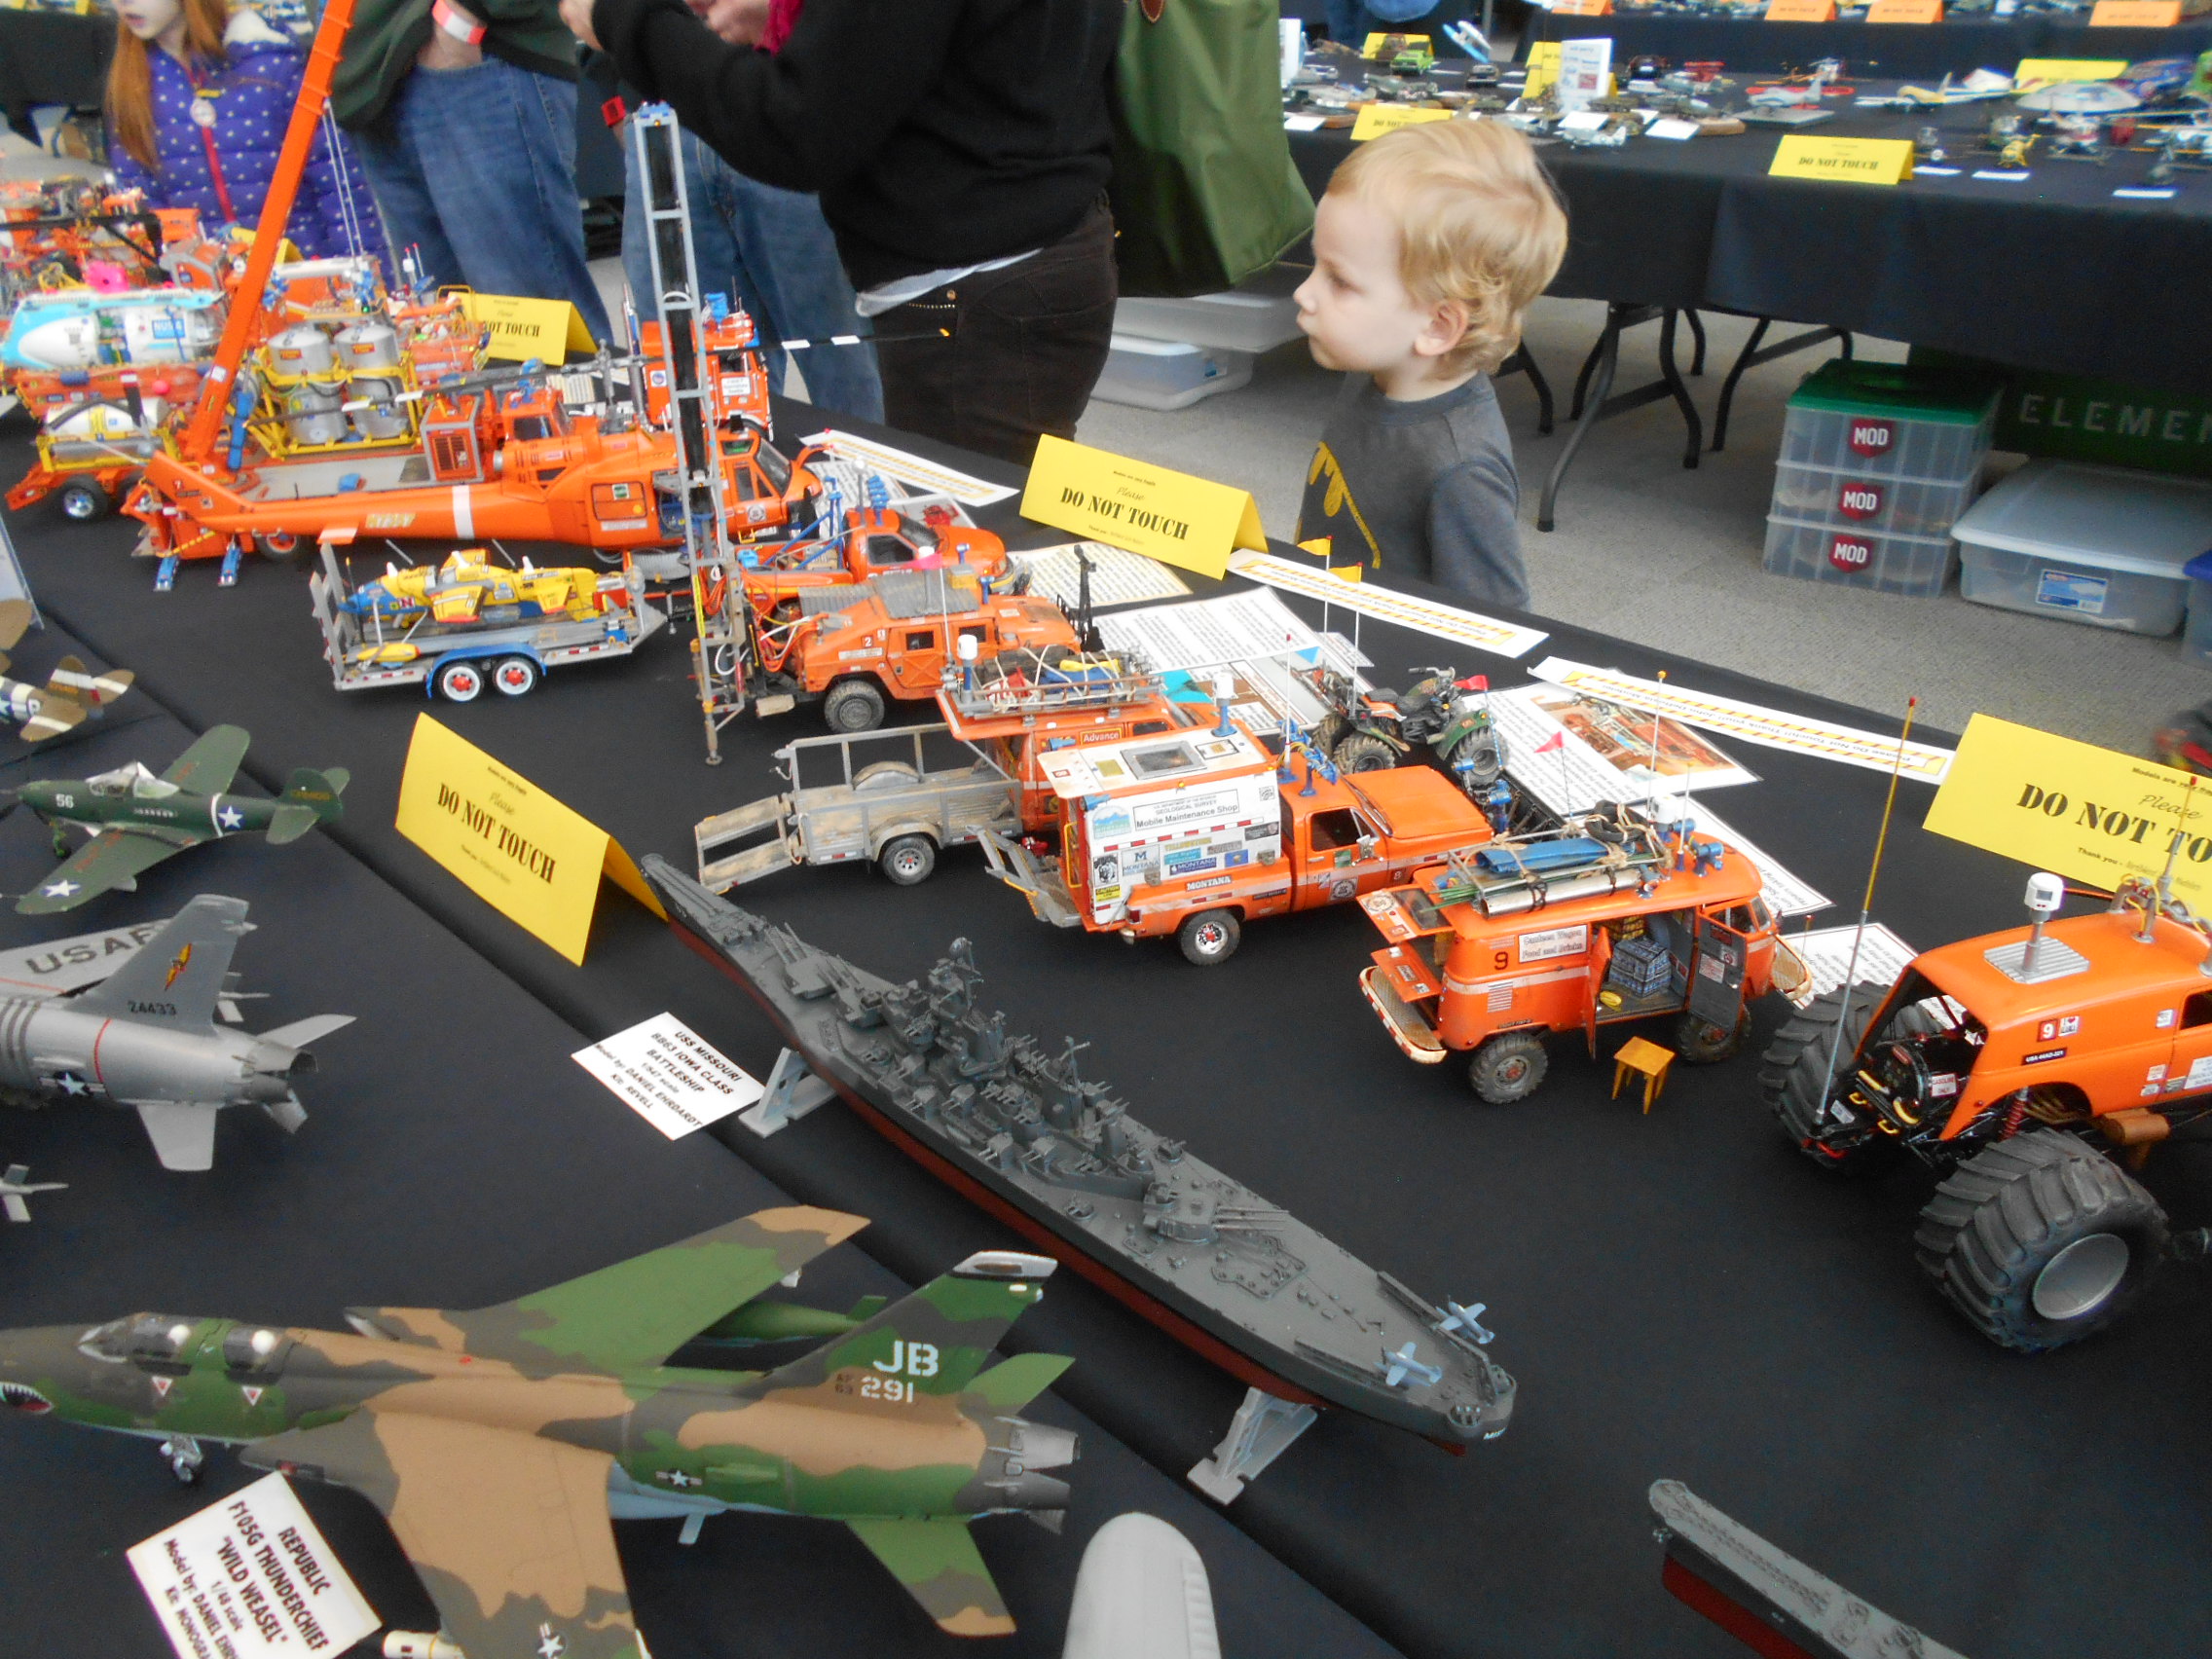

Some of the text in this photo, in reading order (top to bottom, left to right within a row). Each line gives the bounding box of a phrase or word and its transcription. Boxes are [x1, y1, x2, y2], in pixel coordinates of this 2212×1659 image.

[1798, 157, 1879, 170] DO NOT TOUCH
[505, 321, 540, 337] TOUCH
[1854, 426, 1890, 447] MOD
[1117, 487, 1145, 501] Please
[1842, 491, 1878, 512] MOD
[1060, 487, 1190, 541] DO NOT TOUCH
[1833, 543, 1868, 565] MOD
[865, 637, 872, 647] 2
[1084, 732, 1120, 743] Advance
[1830, 740, 1850, 750] Not
[2132, 767, 2160, 781] Models
[55, 793, 75, 809] 56
[1156, 799, 1217, 816] GEOLOGICAL SURVEY
[1136, 803, 1238, 829] Mobile Maintenance Shop
[2016, 783, 2068, 818] DO
[2075, 801, 2157, 844] NOT
[438, 782, 460, 816] DO
[461, 798, 496, 840] NOT
[498, 824, 558, 885] TOUCH
[1134, 851, 1147, 861] M
[1177, 858, 1216, 869] MONTANA
[2078, 846, 2119, 866] Thank you
[1186, 875, 1232, 891] MONTANA
[25, 928, 156, 975] USAF
[1493, 951, 1509, 971] 9
[127, 1000, 177, 1015] 24433
[2043, 1022, 2055, 1039] 9
[651, 1032, 734, 1095] BB63 IOWA CLASS
[675, 1031, 742, 1082] USS MISSOURI
[594, 1044, 617, 1060] Model
[625, 1067, 655, 1092] DANIEL
[646, 1049, 705, 1093] BATTLESHIP
[625, 1086, 653, 1110] REVELL
[872, 1340, 939, 1378] JB
[861, 1376, 914, 1403] 291
[278, 1527, 331, 1596] REPUBLIC
[228, 1500, 330, 1650] F105G THUNDERCHIEF
[164, 1538, 191, 1575] Model
[192, 1592, 222, 1636] DANIEL
[217, 1535, 288, 1643] "WILD WEASEL"
[210, 1580, 243, 1632] 1/48 scale
